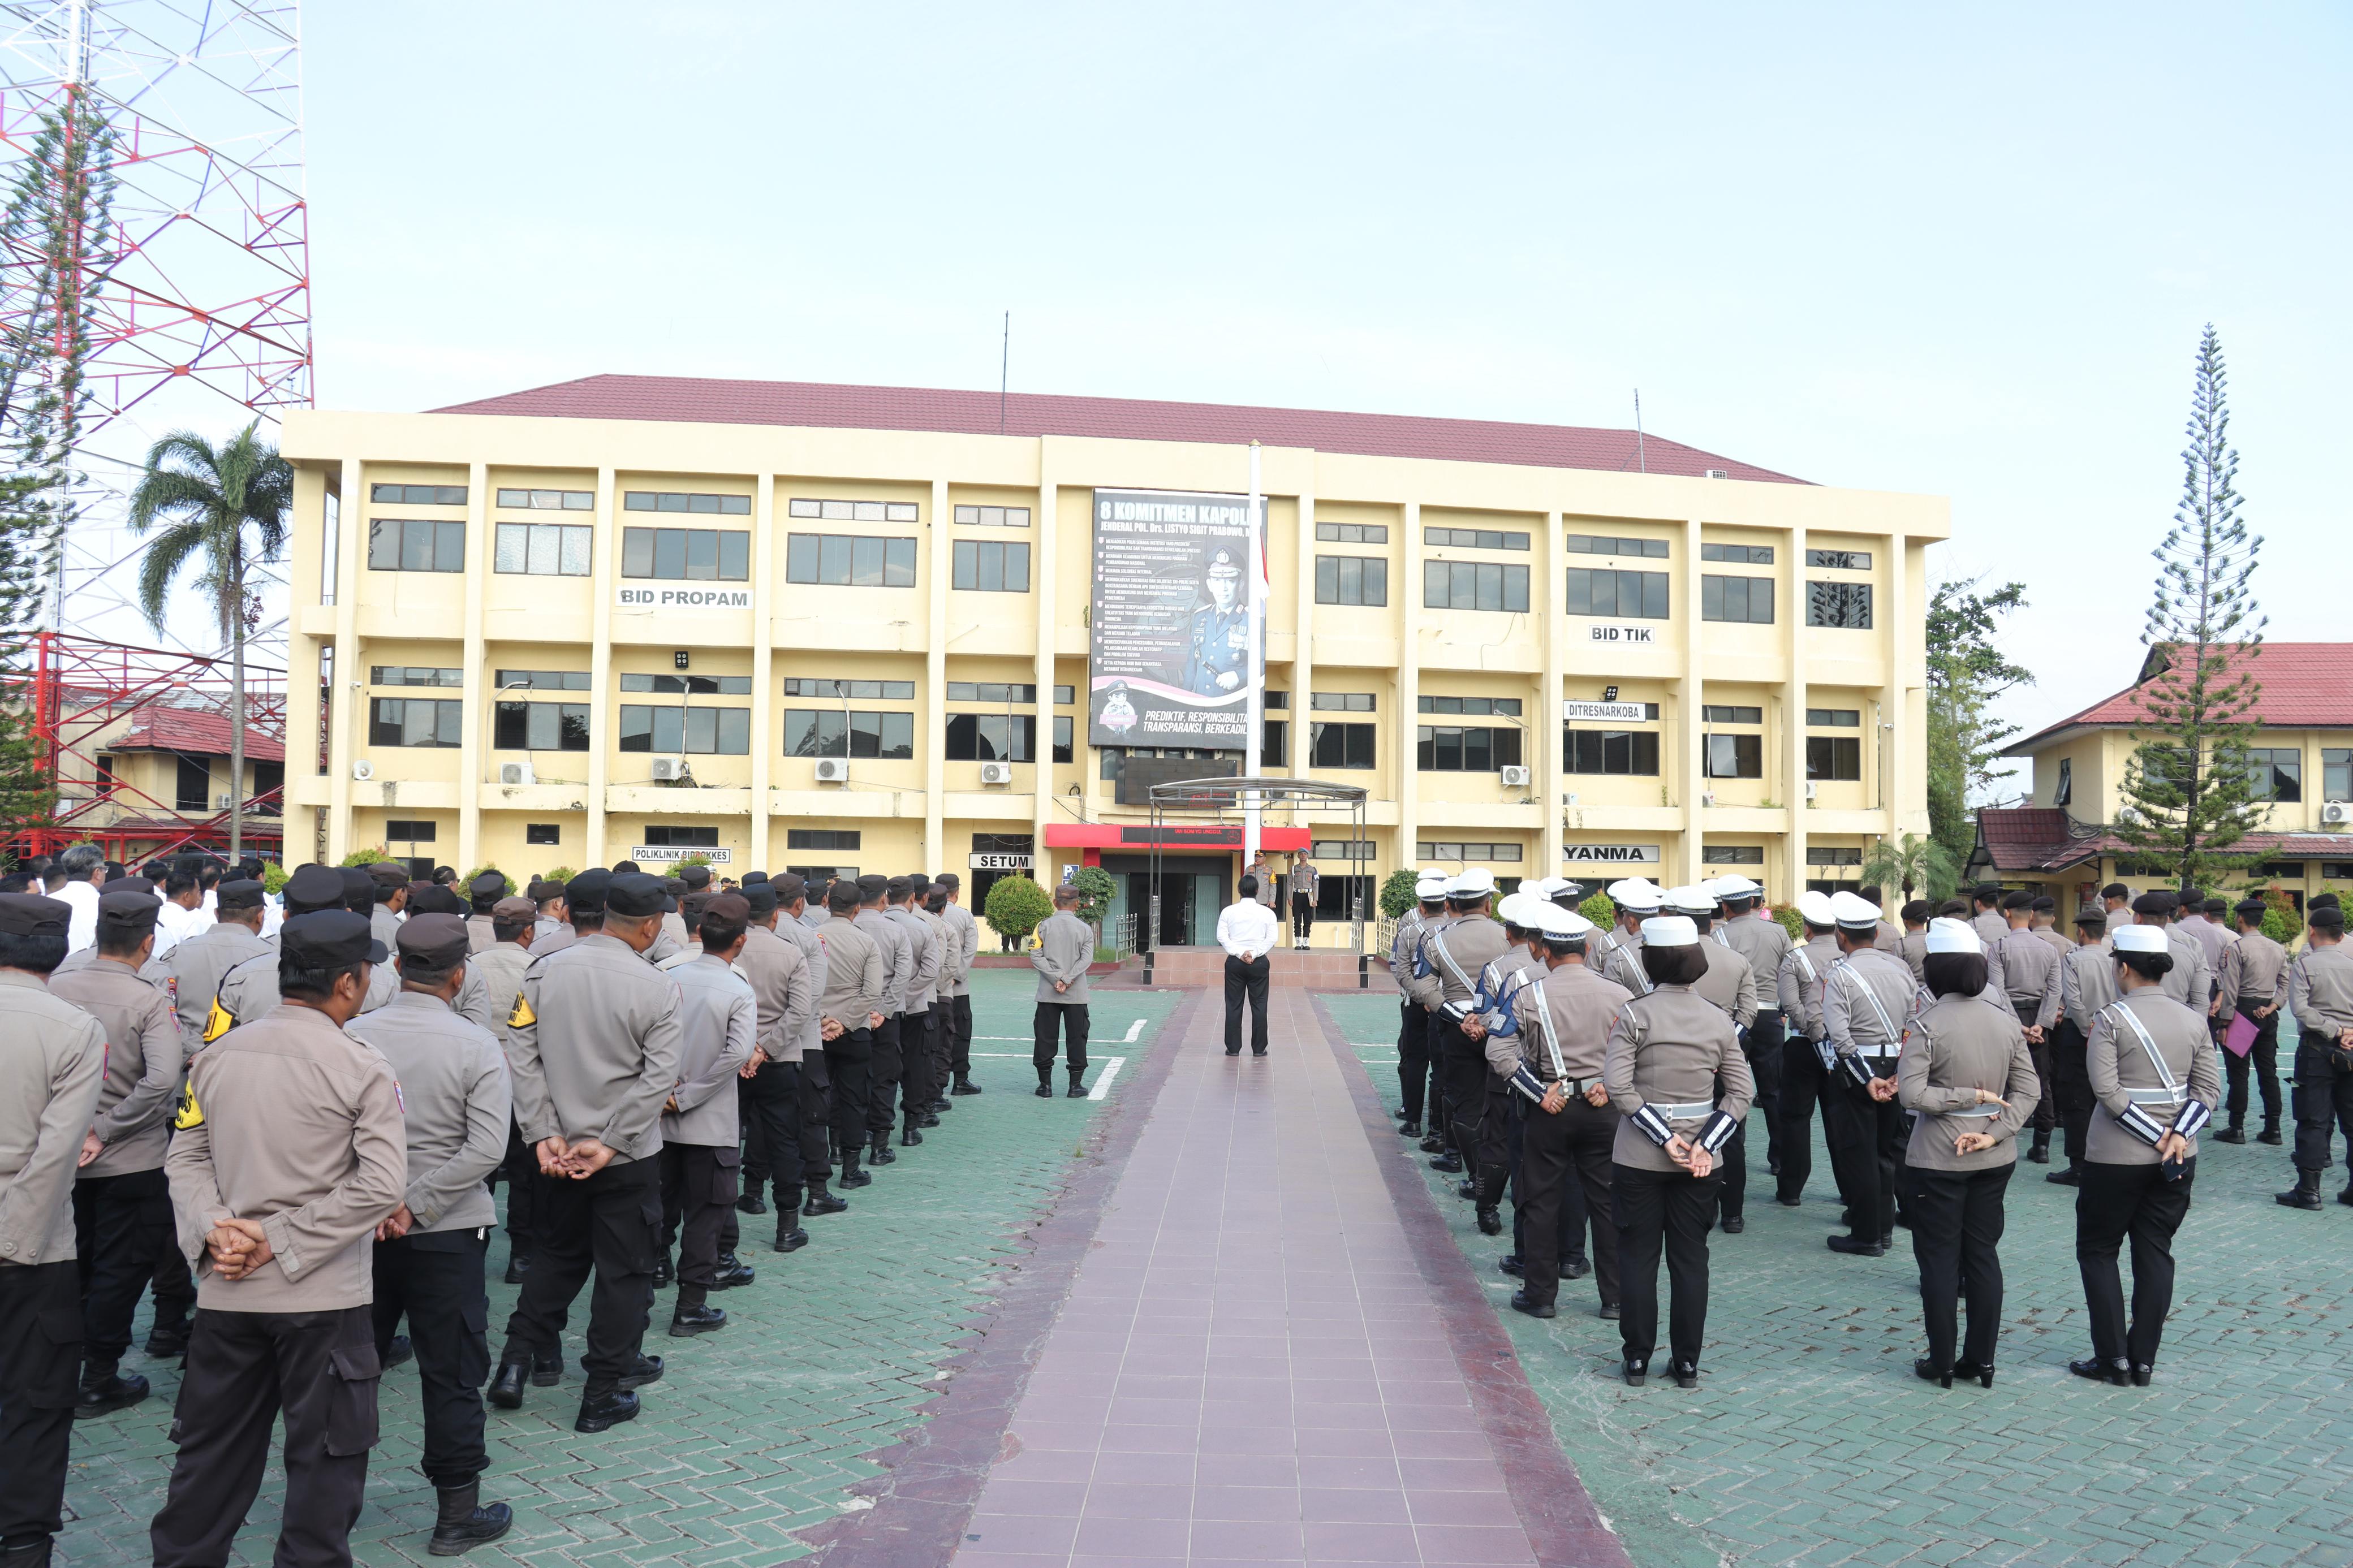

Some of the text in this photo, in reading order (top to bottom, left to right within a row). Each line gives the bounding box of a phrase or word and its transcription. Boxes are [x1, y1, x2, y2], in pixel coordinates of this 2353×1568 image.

[1101, 501, 1111, 520] 8
[1114, 502, 1196, 522] KOMITMEN
[1101, 521, 1133, 532] JENDERAL
[1134, 522, 1149, 532] POL.
[1150, 523, 1163, 533] Drs.
[1165, 524, 1188, 533] LISTYO
[1190, 525, 1208, 534] SIGIT
[1209, 525, 1244, 537] PRABOWO,
[622, 590, 747, 606] BID PROPAM
[1592, 627, 1651, 641] BID TIK
[1145, 711, 1186, 723] PREDIKTIF,
[1188, 711, 1248, 723] RESPONSIBILITA
[1569, 704, 1639, 718] DITRESNARKOBA
[1143, 722, 1248, 734] TRANSPARANSI, BERKEADIL
[636, 849, 679, 859] POLIKLINIK
[1563, 846, 1644, 860] YANMA
[980, 856, 1028, 867] SETUM
[1064, 866, 1072, 876] P
